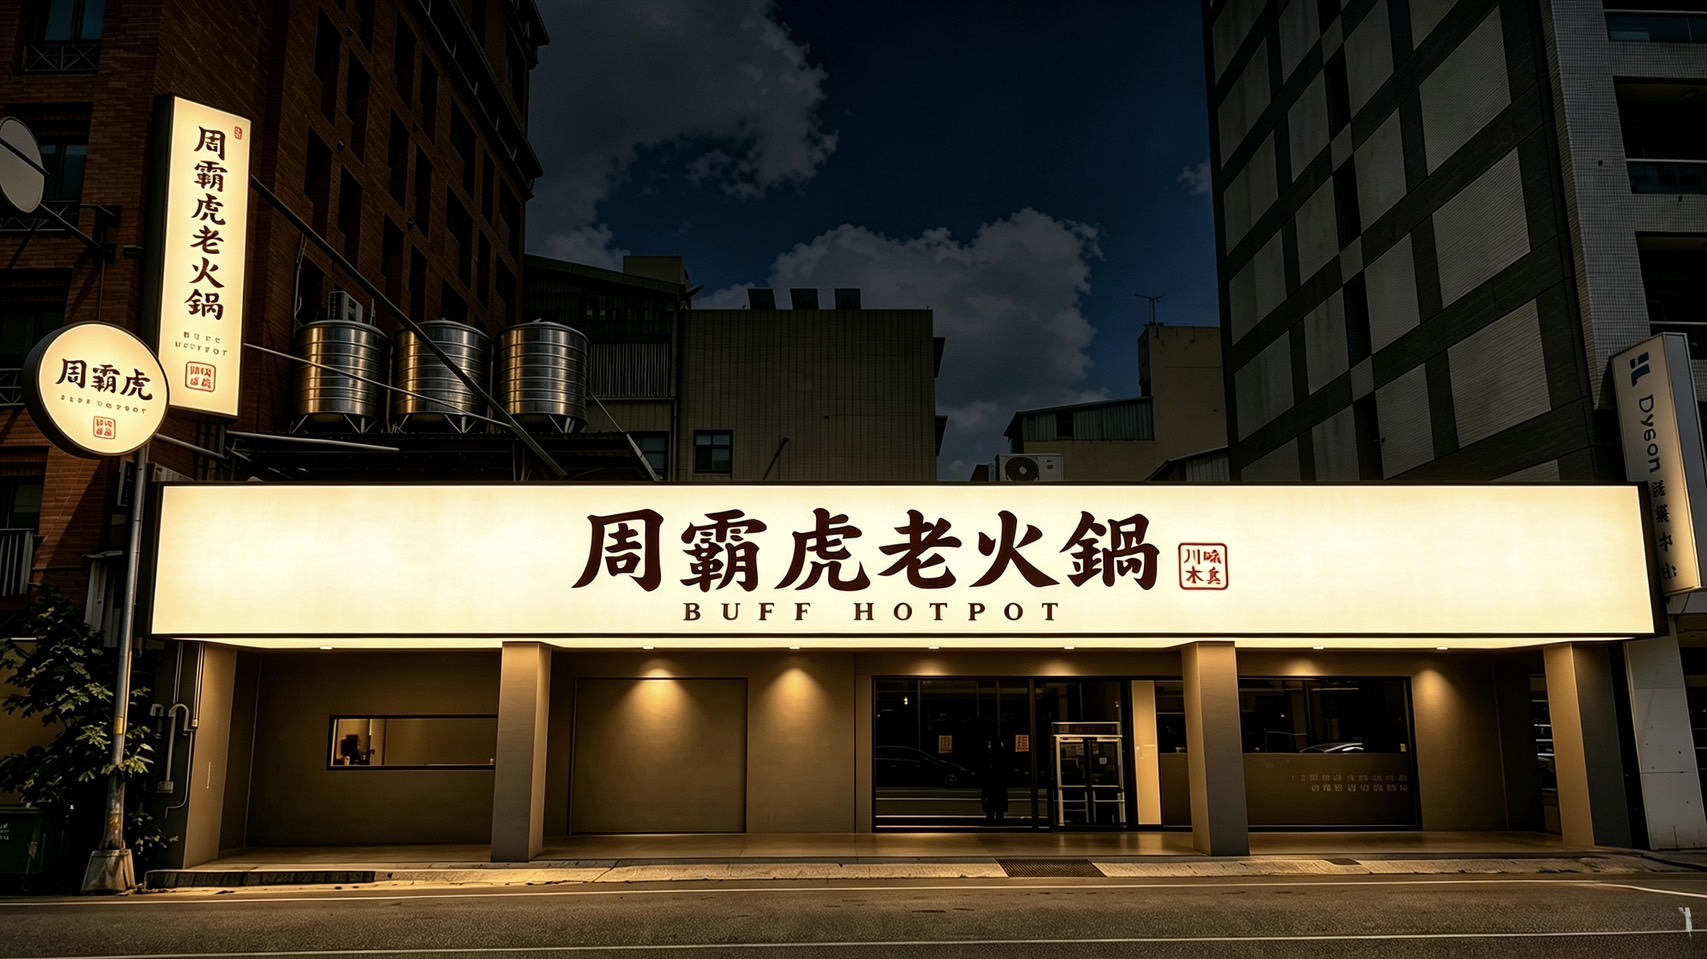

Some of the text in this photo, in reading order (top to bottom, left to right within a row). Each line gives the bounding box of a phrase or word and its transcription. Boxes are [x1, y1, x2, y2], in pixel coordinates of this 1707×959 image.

[184, 125, 228, 321] 周霸虎老火鍋
[56, 358, 153, 401] 周霸虎
[1639, 394, 1661, 473] Dyson
[571, 508, 1160, 592] 周霸虎老火鍋
[683, 602, 1059, 622] BUFF HOTPOT
